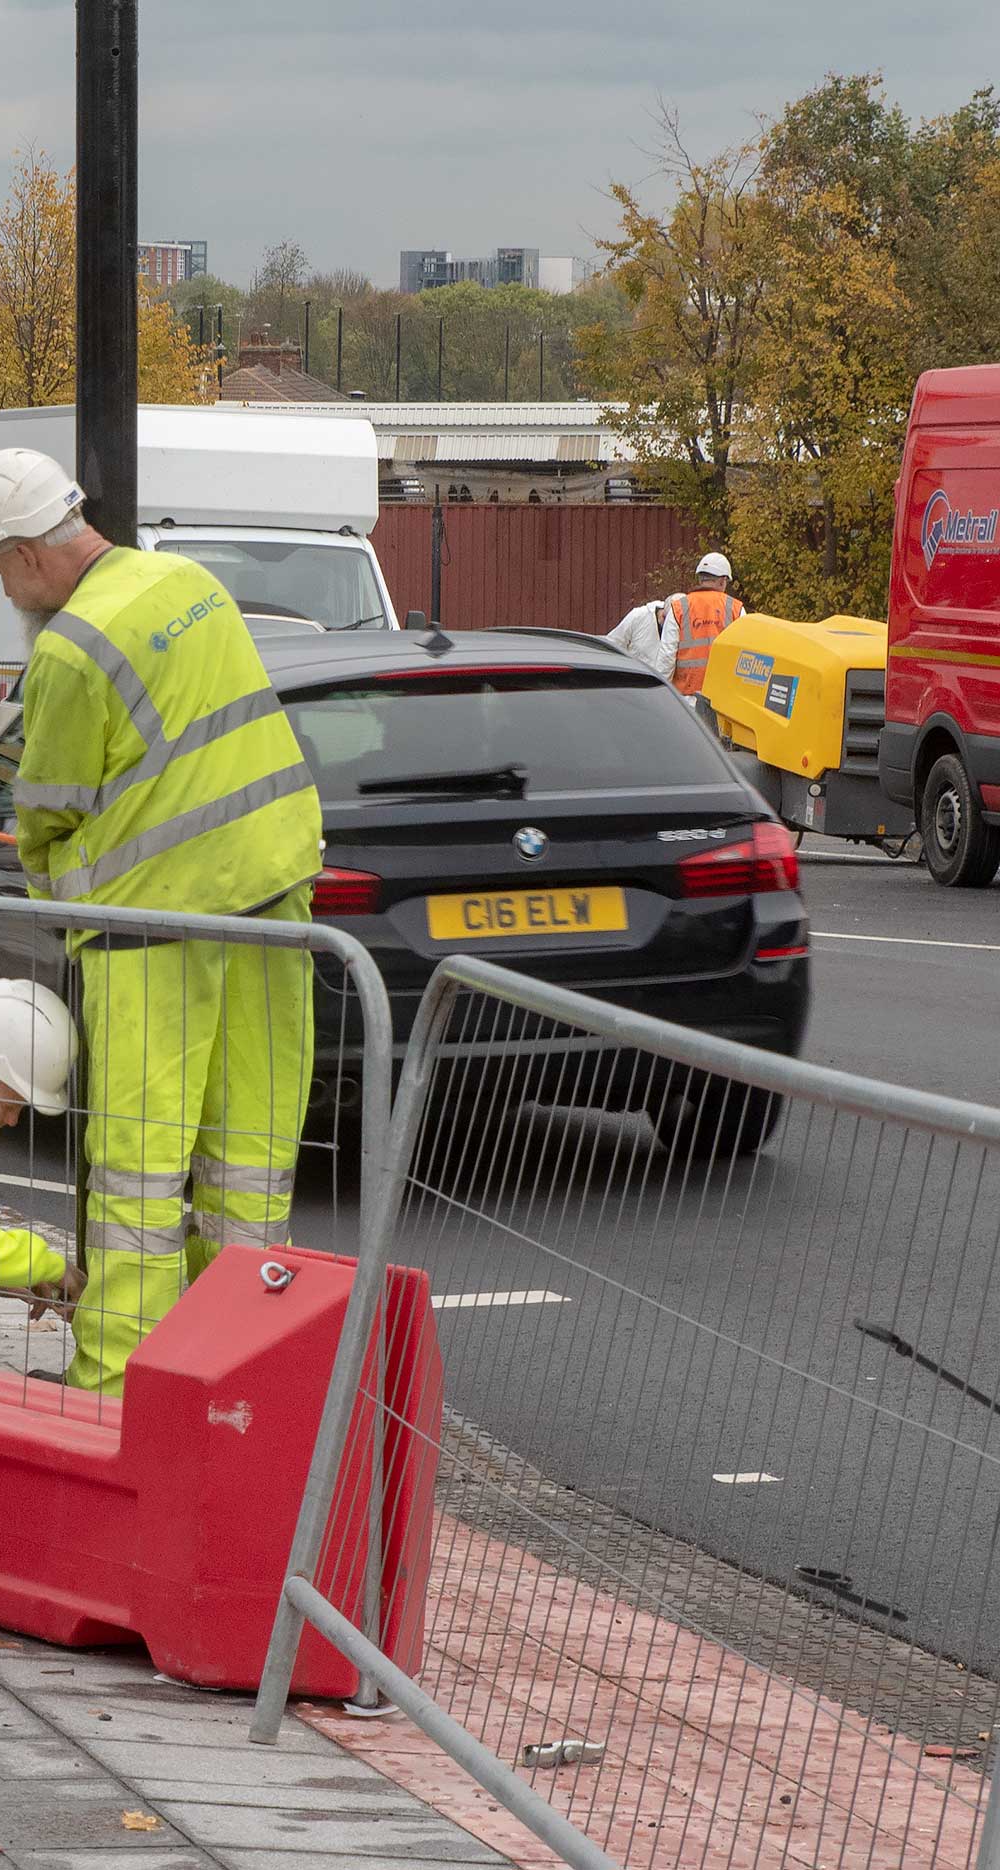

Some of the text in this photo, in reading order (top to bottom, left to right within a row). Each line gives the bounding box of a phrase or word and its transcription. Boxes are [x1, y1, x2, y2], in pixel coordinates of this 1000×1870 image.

[944, 508, 999, 543] Metrail
[166, 592, 226, 638] CUBIC
[462, 894, 590, 930] C16 ELW
